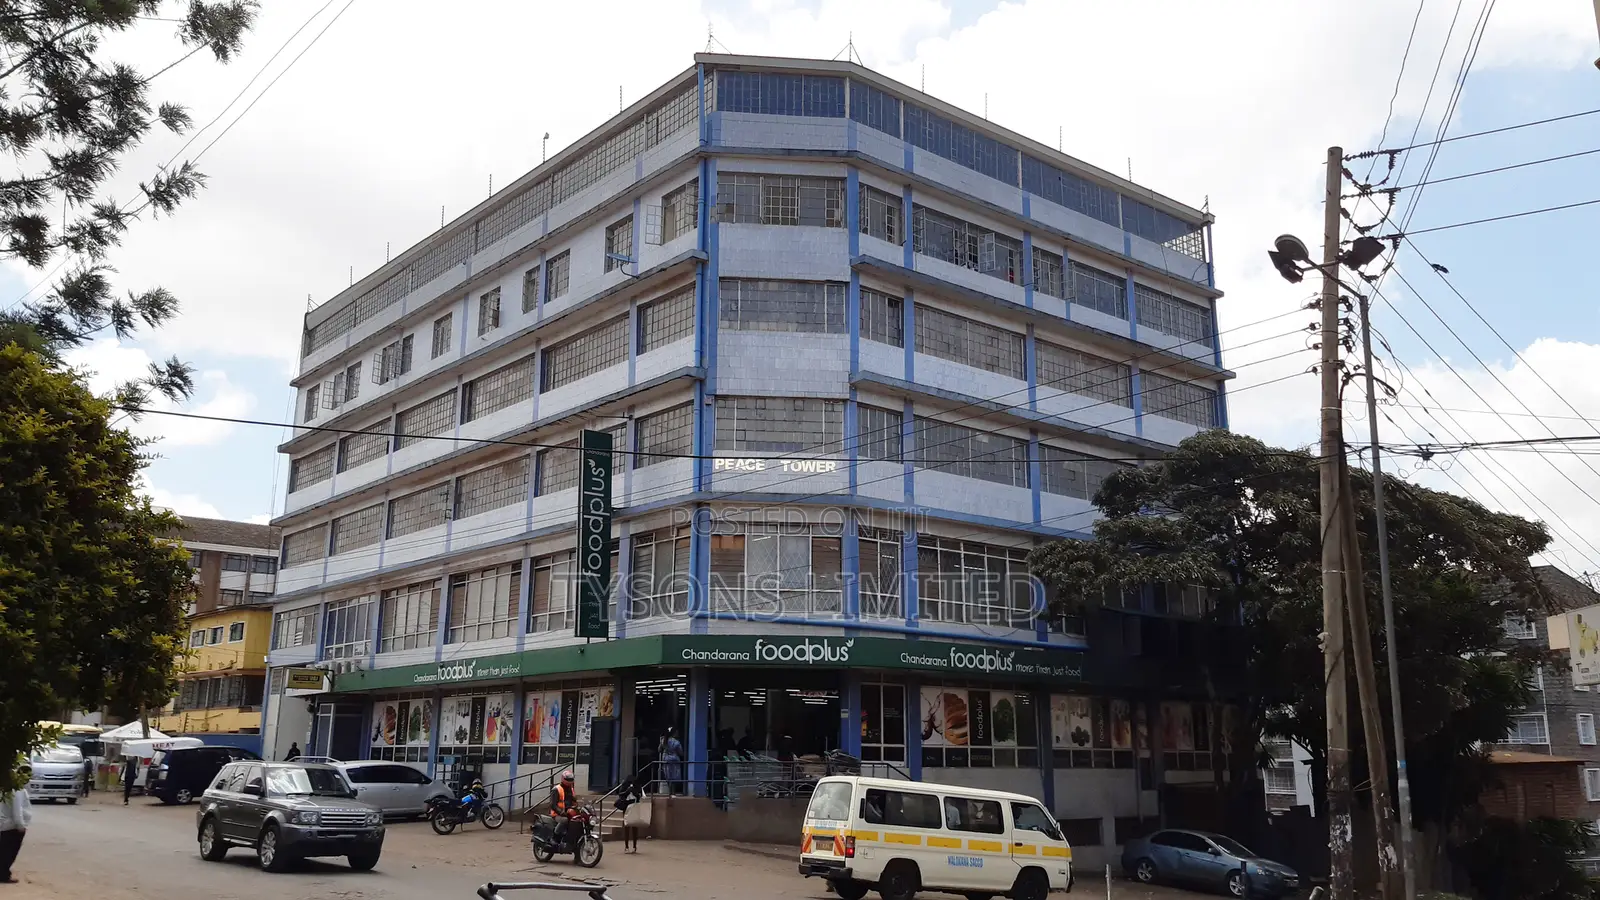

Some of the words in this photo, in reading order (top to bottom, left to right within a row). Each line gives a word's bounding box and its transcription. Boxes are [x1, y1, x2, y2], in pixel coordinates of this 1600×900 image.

[714, 458, 766, 471] PEACE
[780, 459, 837, 473] TOWER
[582, 467, 611, 577] foodplus
[682, 648, 750, 661] Chandarana
[754, 638, 849, 664] foodplus
[900, 652, 947, 667] Chandarana
[950, 646, 1013, 673] foodplus
[1015, 664, 1034, 673] more
[1064, 664, 1081, 677] food
[413, 673, 437, 683] Chandarana
[565, 700, 573, 738] foodplus
